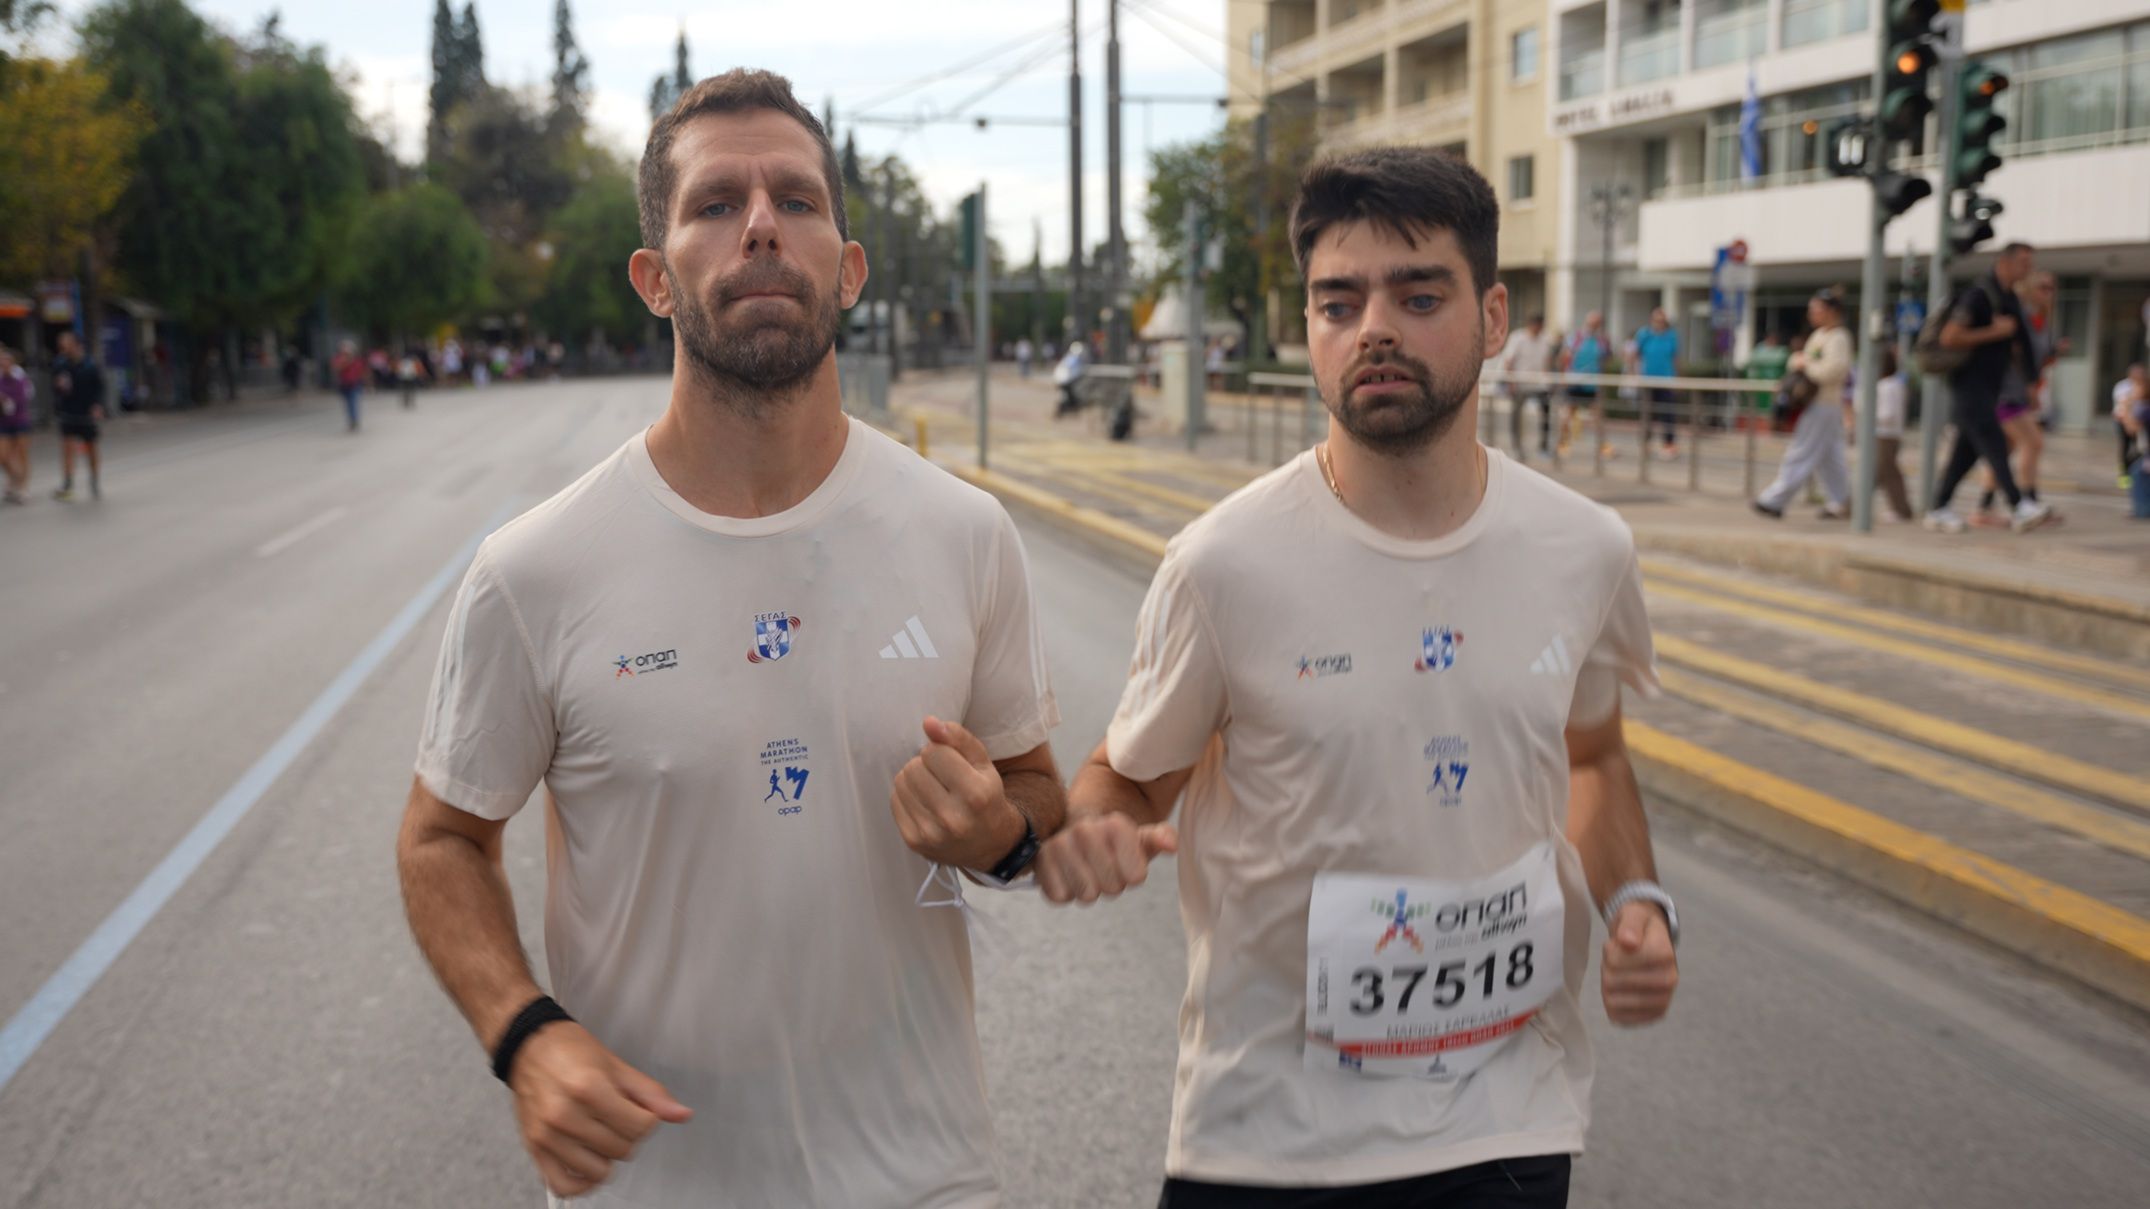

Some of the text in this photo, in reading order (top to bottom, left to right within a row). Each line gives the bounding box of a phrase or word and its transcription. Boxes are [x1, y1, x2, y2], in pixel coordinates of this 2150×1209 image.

[767, 738, 799, 749] ATHENS
[760, 746, 808, 759] MARATHON
[1350, 938, 1534, 1017] 37518
